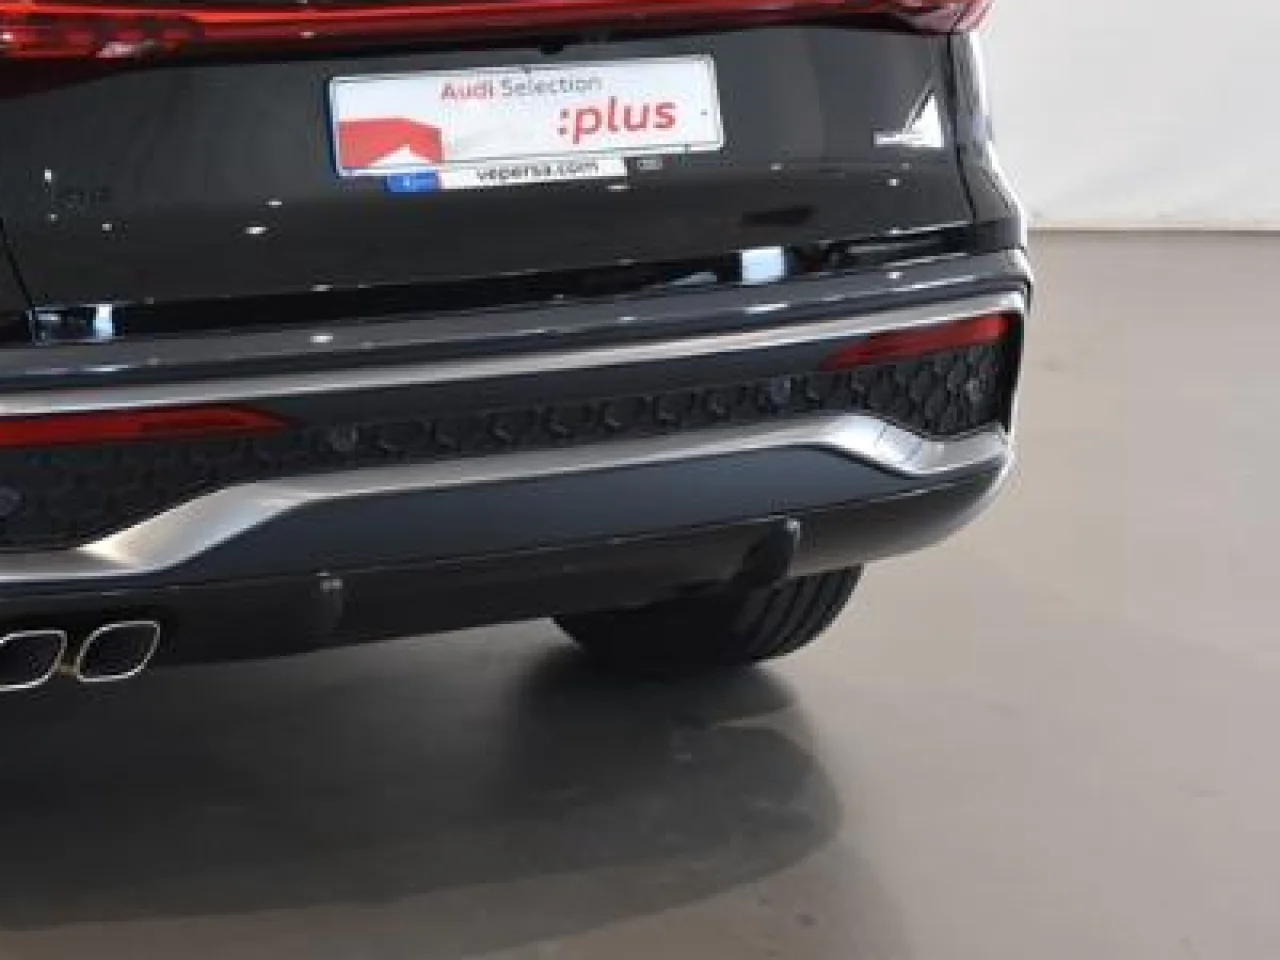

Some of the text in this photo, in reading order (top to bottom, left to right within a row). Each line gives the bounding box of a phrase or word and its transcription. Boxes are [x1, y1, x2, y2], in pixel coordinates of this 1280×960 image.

[440, 76, 603, 101] Audi Selection
[558, 95, 678, 144] :plus
